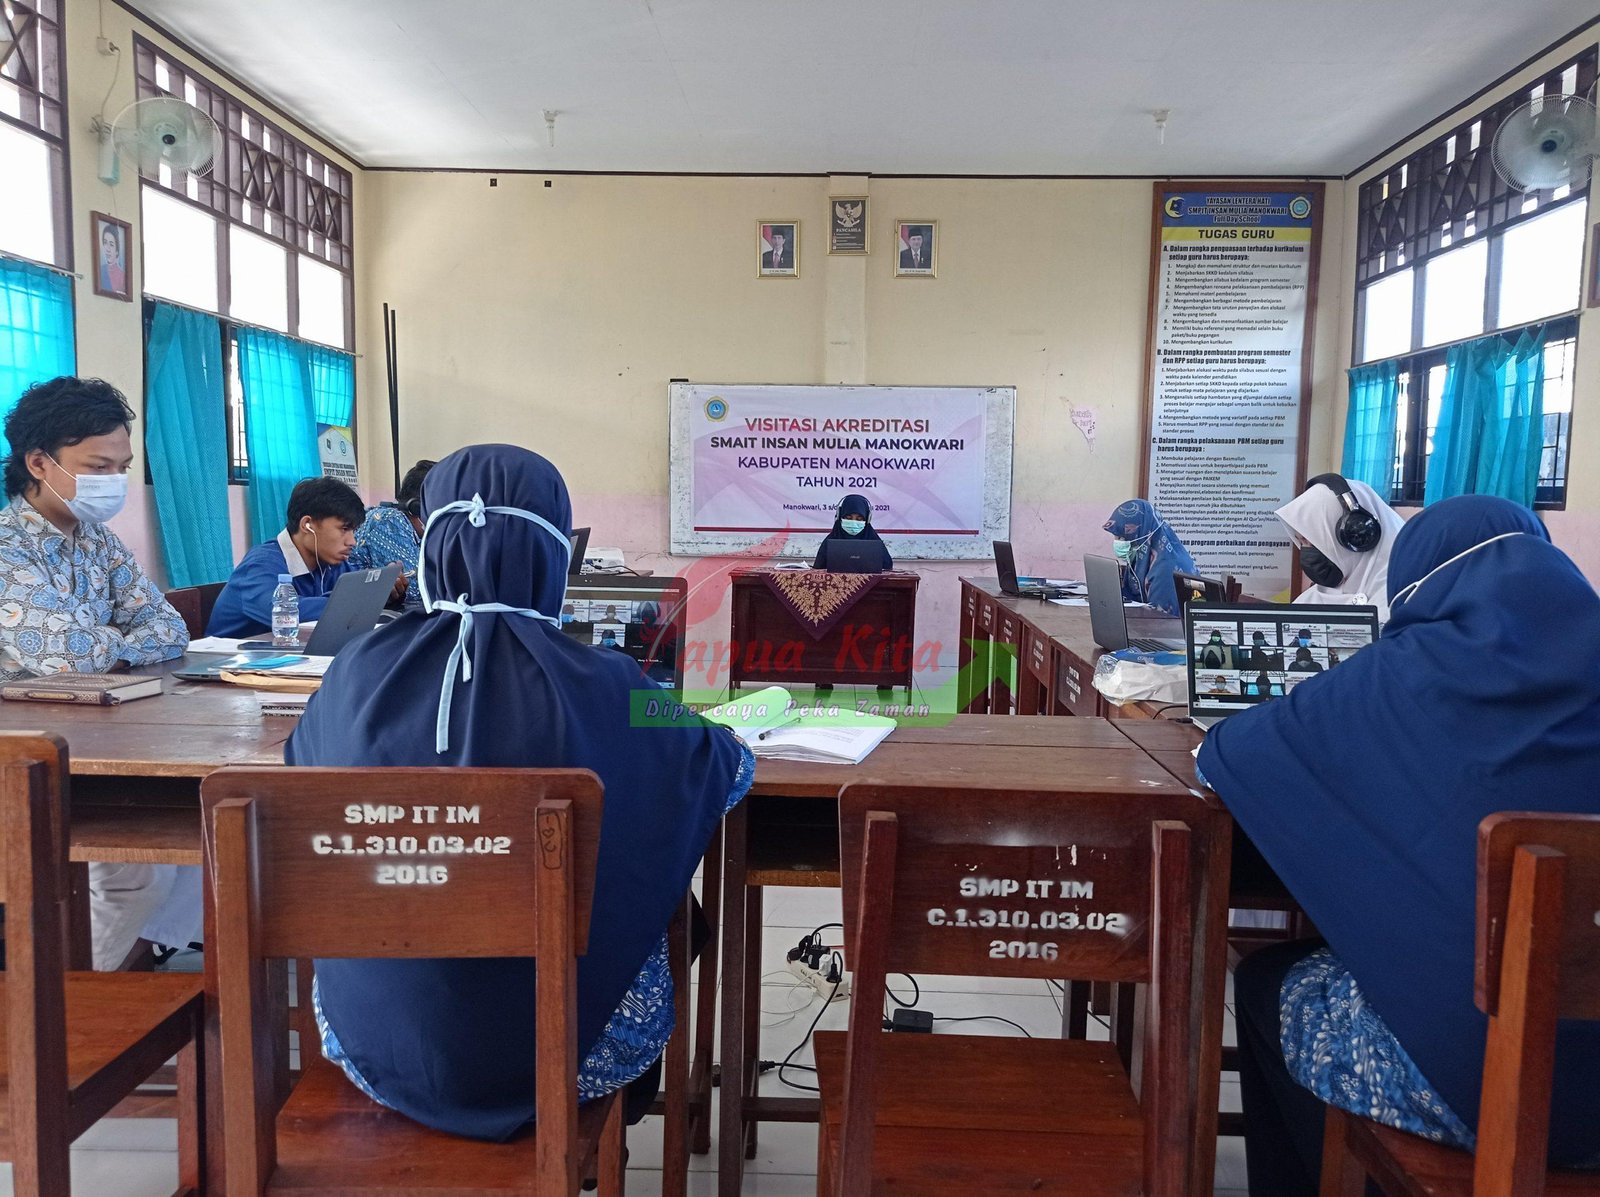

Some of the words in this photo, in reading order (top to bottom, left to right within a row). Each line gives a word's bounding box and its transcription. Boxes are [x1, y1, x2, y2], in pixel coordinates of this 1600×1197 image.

[1198, 230, 1237, 238] TUGAS
[1242, 230, 1274, 239] GURU
[744, 418, 817, 432] VISITASI
[823, 418, 930, 433] AKREDITASI
[710, 436, 757, 448] SMAIT
[762, 437, 808, 449] INSAN
[812, 438, 860, 450] MULIA
[865, 438, 964, 450] MANOKWARI
[738, 456, 830, 469] KABUPATEN
[836, 457, 935, 470] MANOKWARI
[796, 476, 844, 487] TAHUN
[848, 477, 877, 488] 2021
[344, 804, 405, 824] SMP
[412, 806, 439, 823] IT
[446, 806, 480, 823] IM
[312, 834, 511, 854] C.1.310.03.02
[376, 865, 448, 884] 2016
[959, 877, 1019, 897] SMP
[1026, 880, 1053, 898] IT
[1060, 881, 1093, 899] IM
[927, 908, 1128, 934] C.1.310.03.02
[989, 940, 1058, 960] 2016
